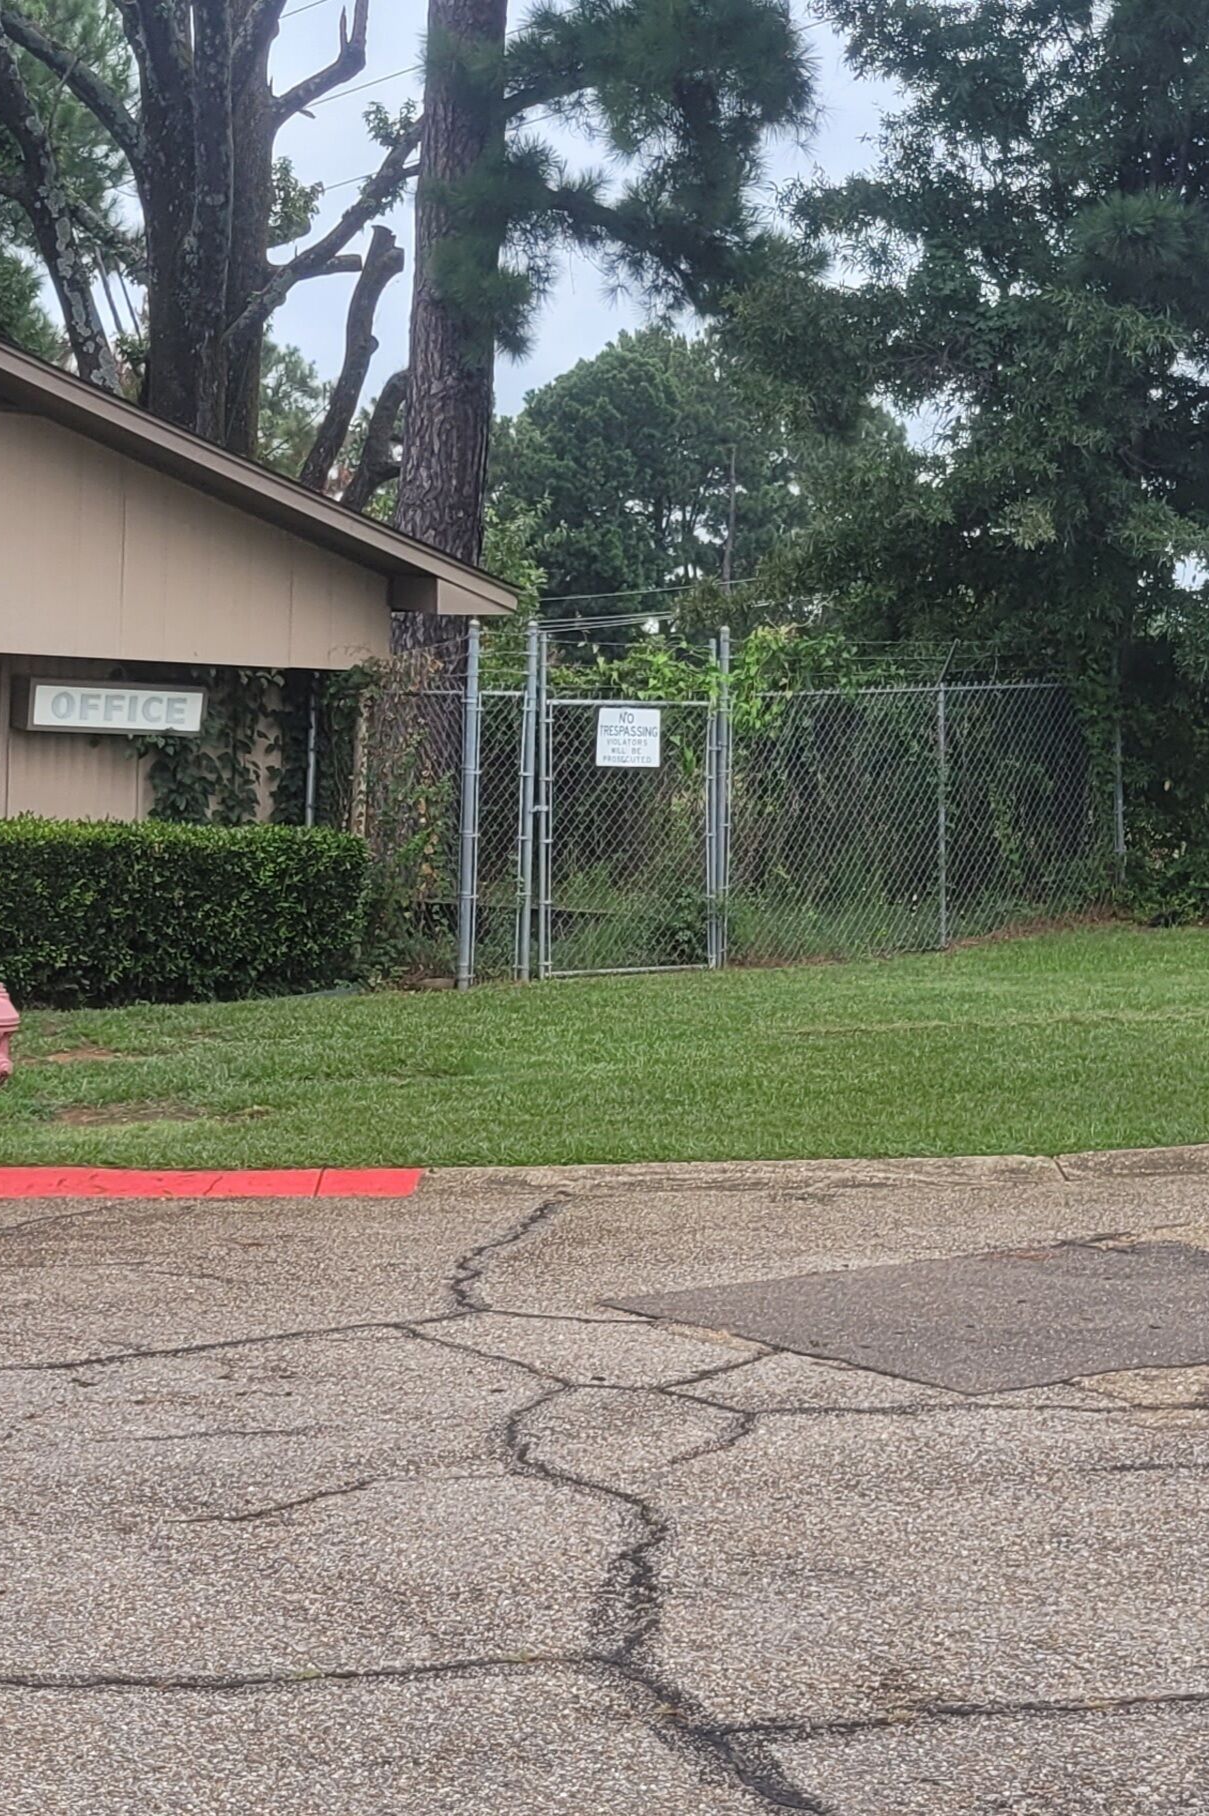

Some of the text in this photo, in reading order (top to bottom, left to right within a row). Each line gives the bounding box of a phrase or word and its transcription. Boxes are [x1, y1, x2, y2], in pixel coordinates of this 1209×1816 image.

[51, 691, 188, 725] OFFICE
[618, 711, 635, 724] NO
[600, 725, 658, 738] TRESPASSING
[606, 739, 649, 747] VIOLATORS
[603, 755, 653, 764] PROSECUTED
